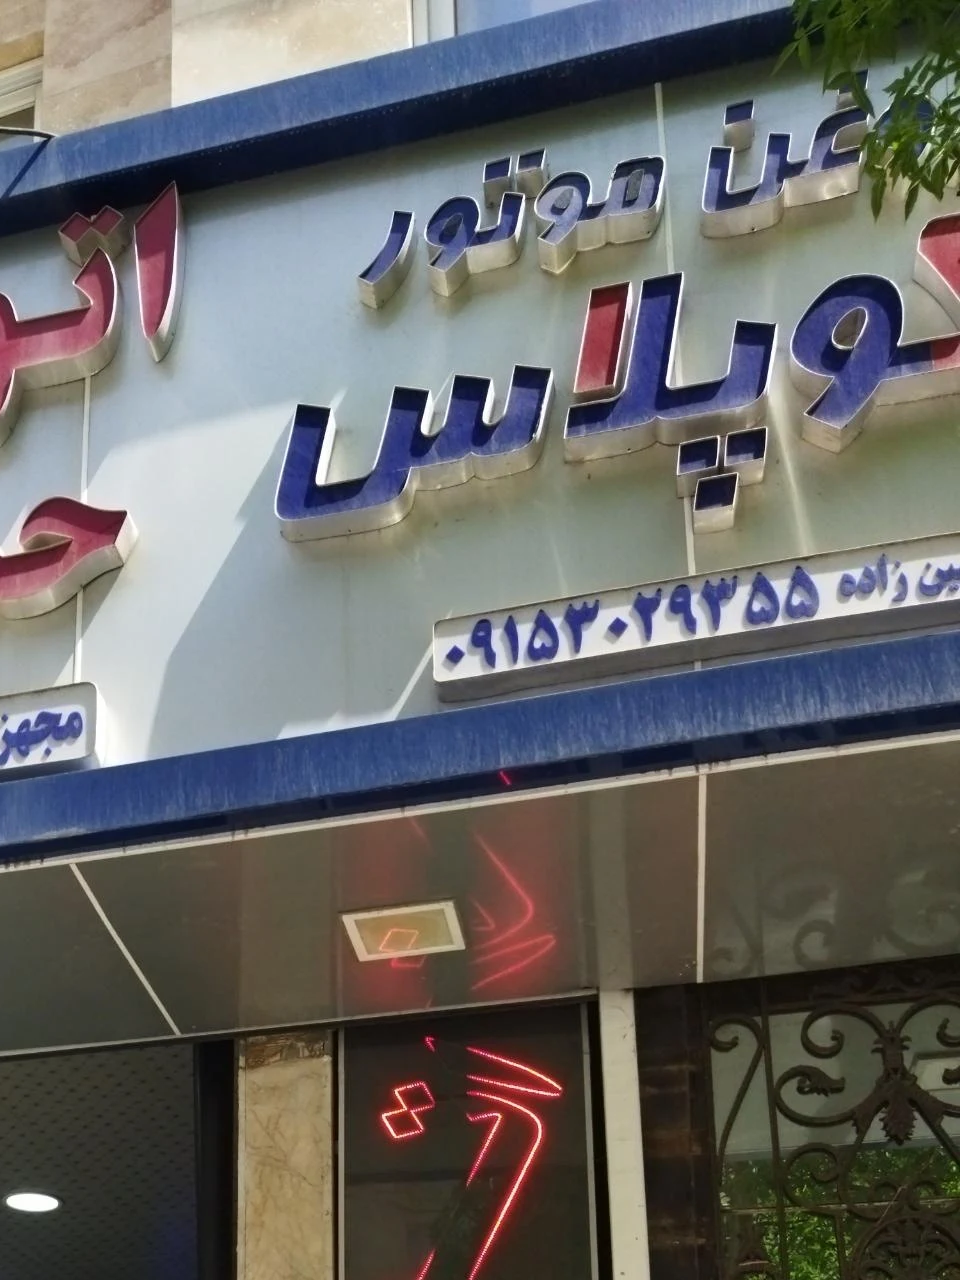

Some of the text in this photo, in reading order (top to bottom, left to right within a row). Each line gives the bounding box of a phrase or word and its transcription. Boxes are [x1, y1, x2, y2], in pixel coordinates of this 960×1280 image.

[357, 147, 666, 308] موتور
[444, 565, 821, 669] ۰۹۱۵۳۰۲۹۳۵۵
[839, 553, 909, 603] زاده
